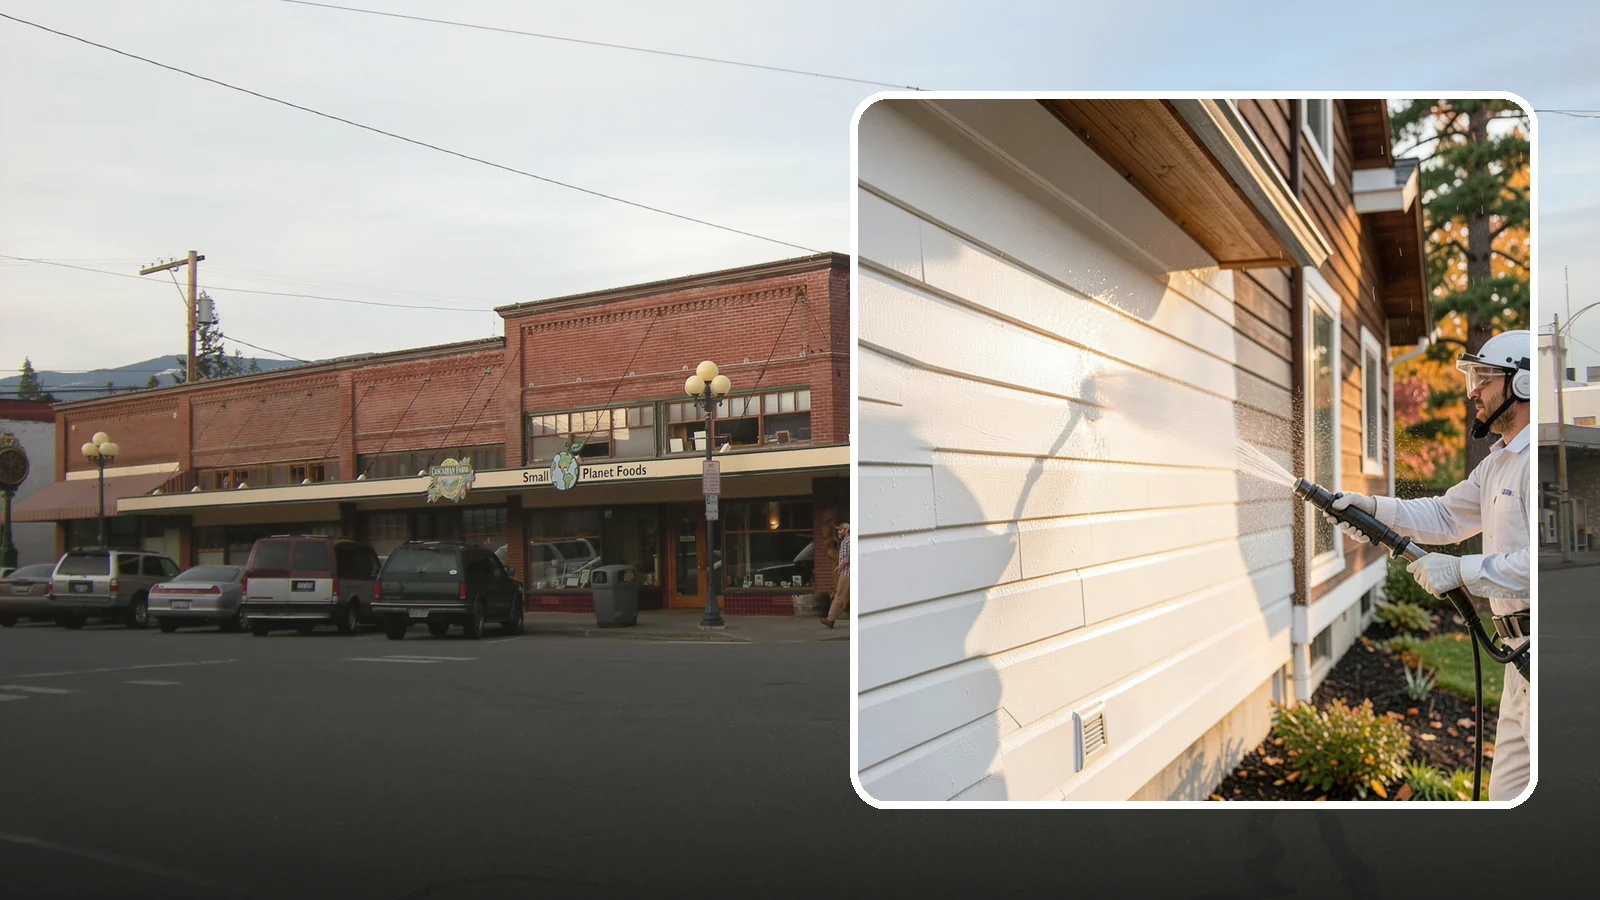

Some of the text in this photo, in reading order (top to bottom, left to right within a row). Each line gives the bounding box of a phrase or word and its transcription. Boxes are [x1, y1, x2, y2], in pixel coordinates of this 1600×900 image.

[455, 466, 469, 474] FARM
[523, 464, 647, 482] Small Planet Foods
